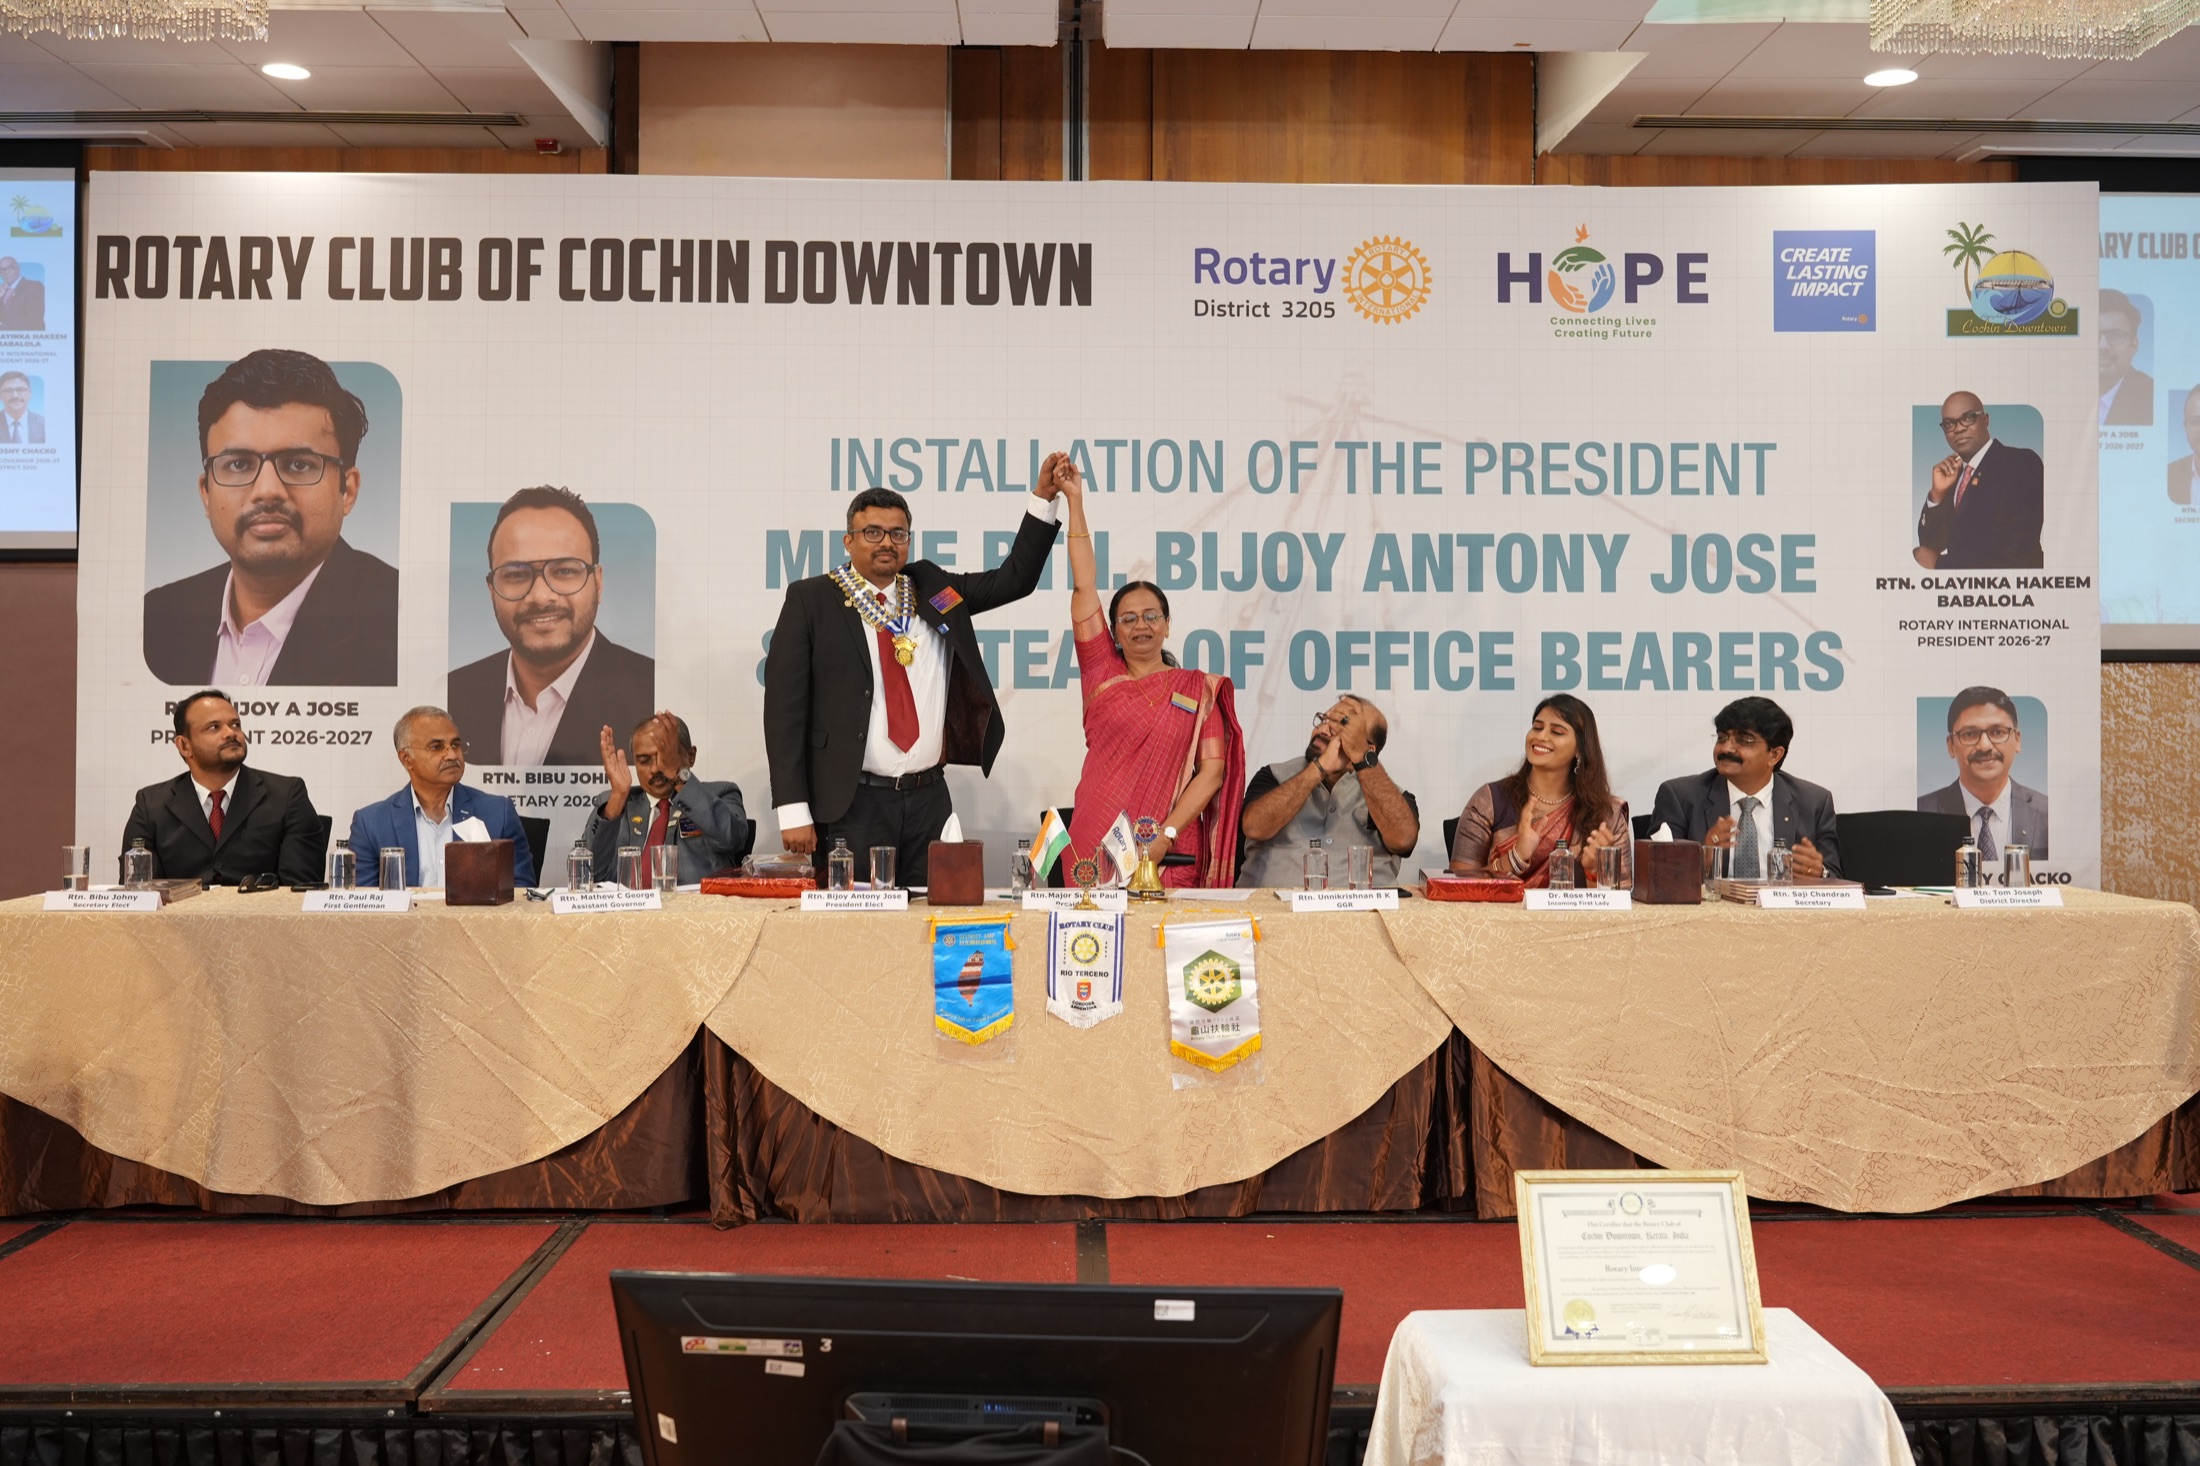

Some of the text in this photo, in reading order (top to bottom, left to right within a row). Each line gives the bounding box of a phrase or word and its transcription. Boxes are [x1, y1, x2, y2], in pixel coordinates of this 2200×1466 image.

[1368, 245, 1406, 256] ROTARY
[2138, 232, 2188, 259] CLUB
[1780, 247, 1852, 263] CREATE
[95, 235, 1092, 307] ROTARY CLUB OF COCHIN DOWNTOWN
[1194, 247, 1337, 294] Rotary
[1786, 264, 1868, 280] LASTING
[1791, 281, 1864, 297] IMPACT
[1194, 299, 1336, 319] District 3205
[1356, 293, 1419, 316] INTERNATIONAL
[1550, 316, 1656, 328] Connecting Lives
[1962, 318, 2067, 333] Cochin Downtown
[1554, 328, 1653, 340] Creating Future
[1247, 440, 1319, 495] OF
[1334, 441, 1443, 495] THE
[1465, 442, 1778, 497] PRESIDENT
[1156, 532, 1346, 594] BIJOY
[1362, 532, 1631, 594] ANTONY
[1650, 533, 1817, 595] JOSE
[1875, 576, 2091, 590] RTN. OLAYINKA HAKEEM
[1937, 594, 2035, 608] BABALOLA
[1899, 618, 2070, 631] ROTARY INTERNATIONAL
[1917, 635, 2051, 647] PRESIDENT 2026-27
[1182, 628, 1265, 691] OF
[1288, 629, 1515, 692] OFFICE
[1541, 630, 1845, 693] BEARERS
[286, 702, 301, 716] A
[306, 701, 359, 717] JOSE
[270, 730, 373, 745] 2026-2027
[482, 772, 520, 784] RTN.
[525, 772, 565, 785] BIBU
[1112, 826, 1128, 852] Rotary
[112, 894, 138, 902] Johny
[370, 894, 384, 902] Raj
[580, 893, 614, 901] Mathew
[625, 892, 655, 900] George
[827, 893, 848, 901] Bijoy
[851, 893, 880, 901] Antony
[1318, 893, 1374, 901] Unnikrishnan
[1792, 891, 1808, 899] Saji
[571, 902, 608, 910] Assistant
[1059, 921, 1114, 932] ROTARY CLUB
[1075, 970, 1109, 978] TERCERO
[820, 1337, 832, 1352] 3
